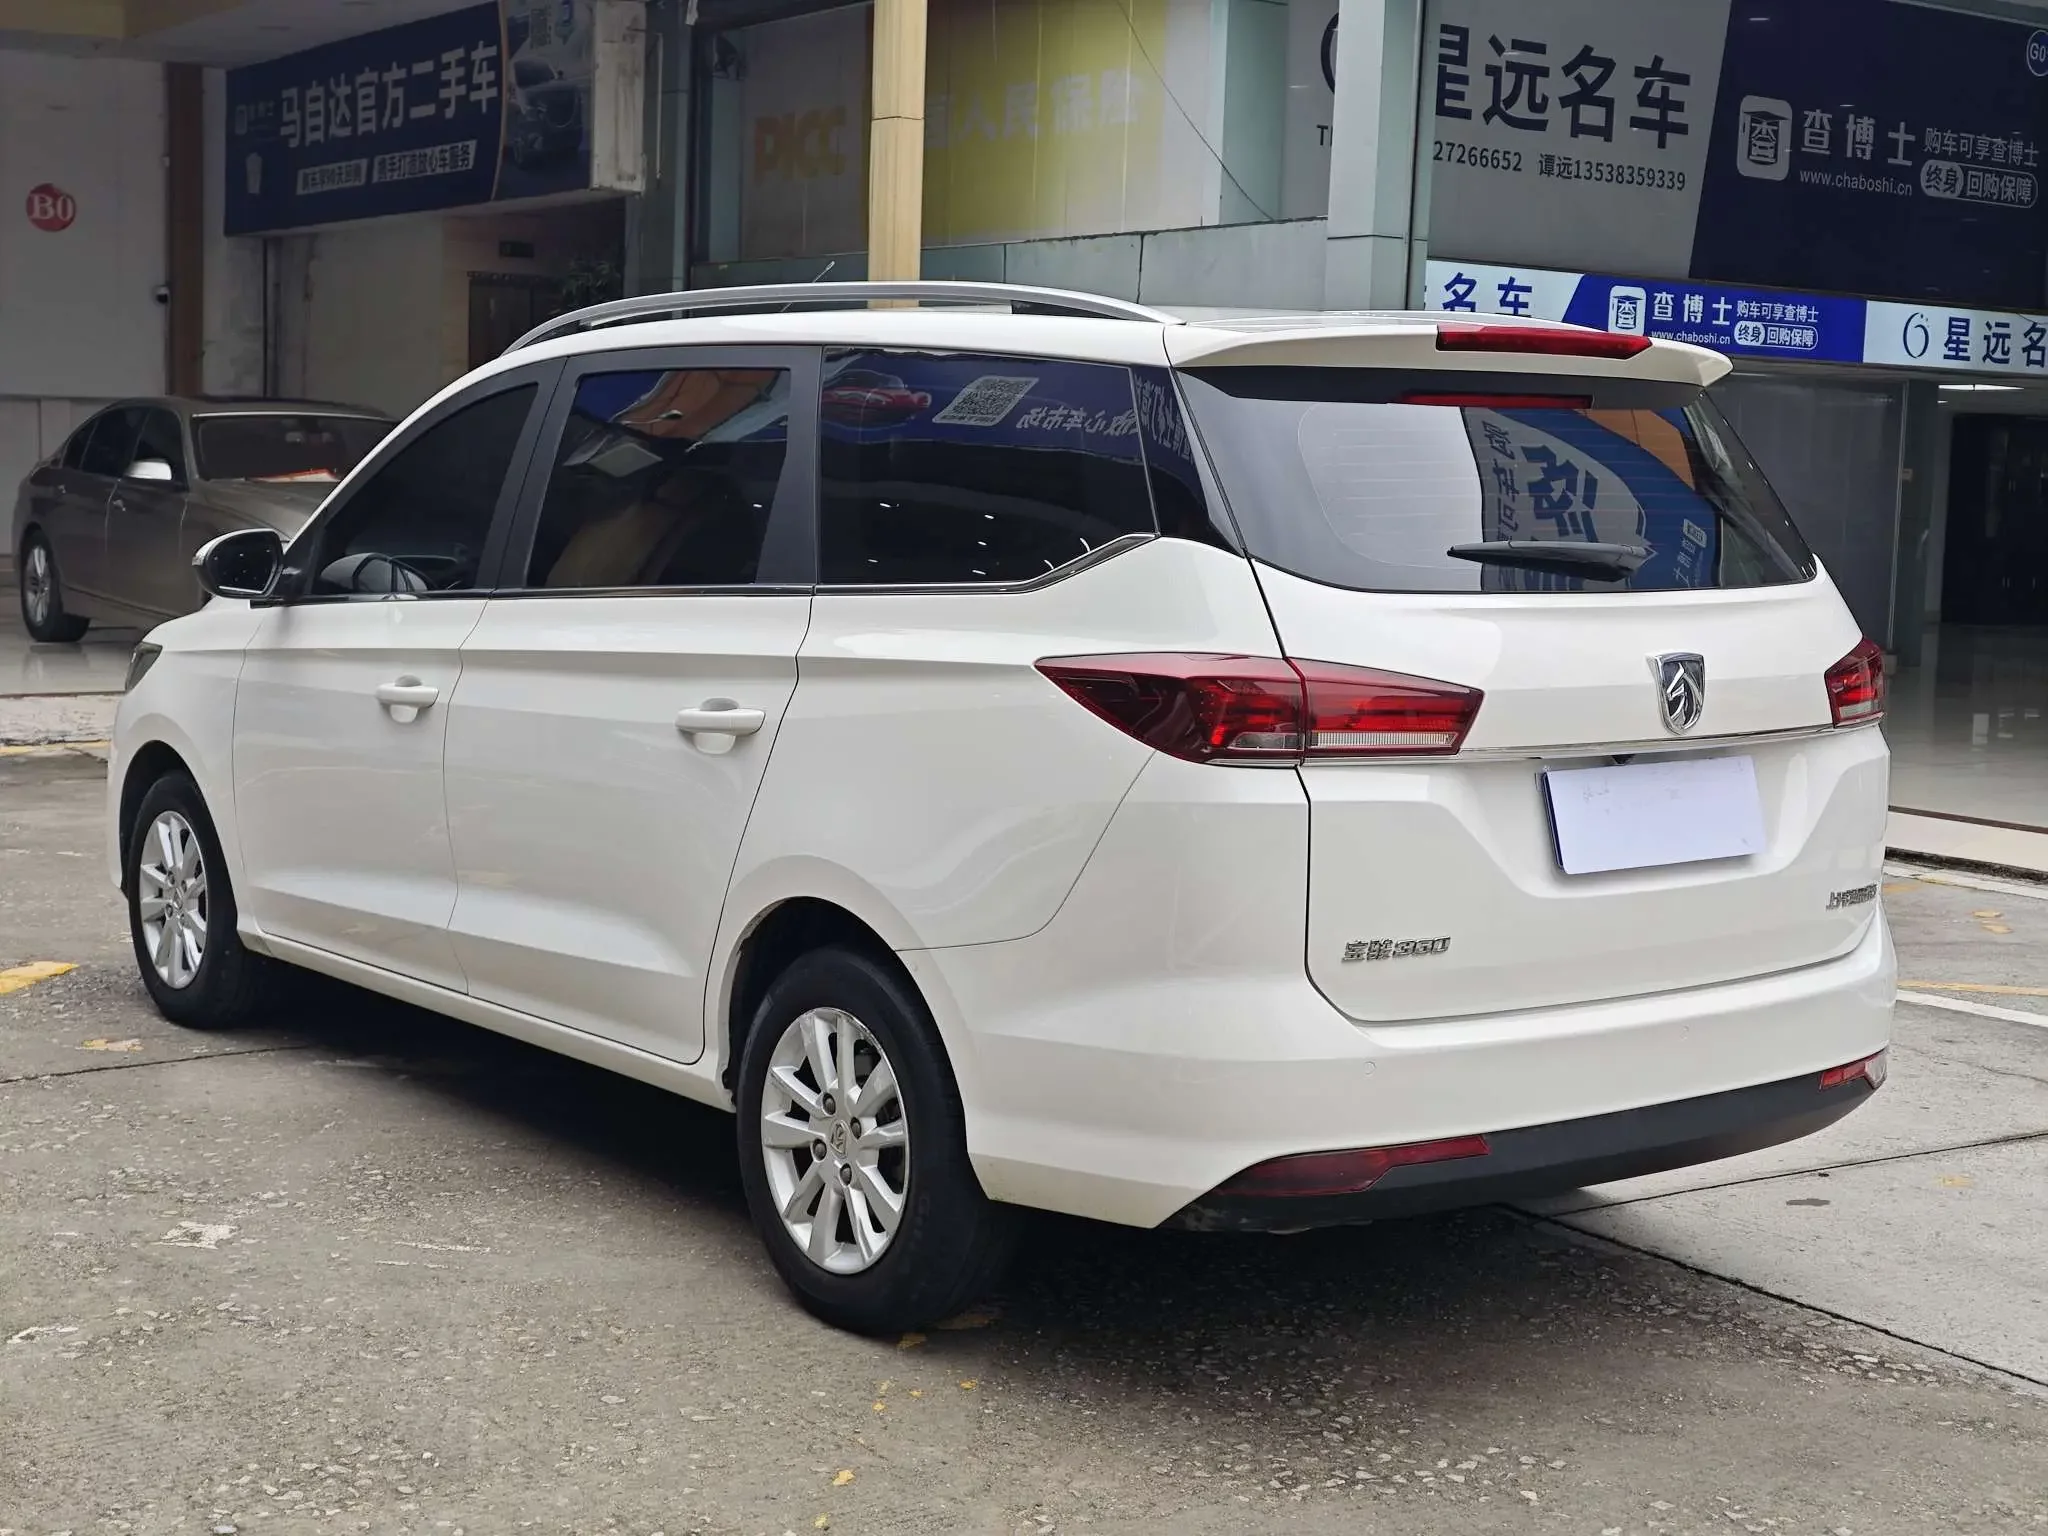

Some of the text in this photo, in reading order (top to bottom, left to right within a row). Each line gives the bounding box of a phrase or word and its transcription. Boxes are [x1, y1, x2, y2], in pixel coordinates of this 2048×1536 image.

[280, 40, 498, 148] 马自达官方二手车
[1435, 23, 1691, 149] 星远名车
[1432, 140, 1523, 172] 27266652
[1801, 109, 1916, 166] 查博士
[1923, 127, 2039, 168] 购车可享查博士
[1799, 169, 1913, 197] www.chaboshi.cn
[1924, 163, 2033, 204] 终身 回购保障
[1442, 272, 1532, 316] 名车
[1652, 291, 1733, 326] 查博士
[1736, 300, 1819, 323] 购车可享查博士
[1651, 330, 1731, 345] www.chaboshi.cn
[1737, 323, 1815, 347] 终身 回购保障
[1943, 316, 2047, 368] 星远名
